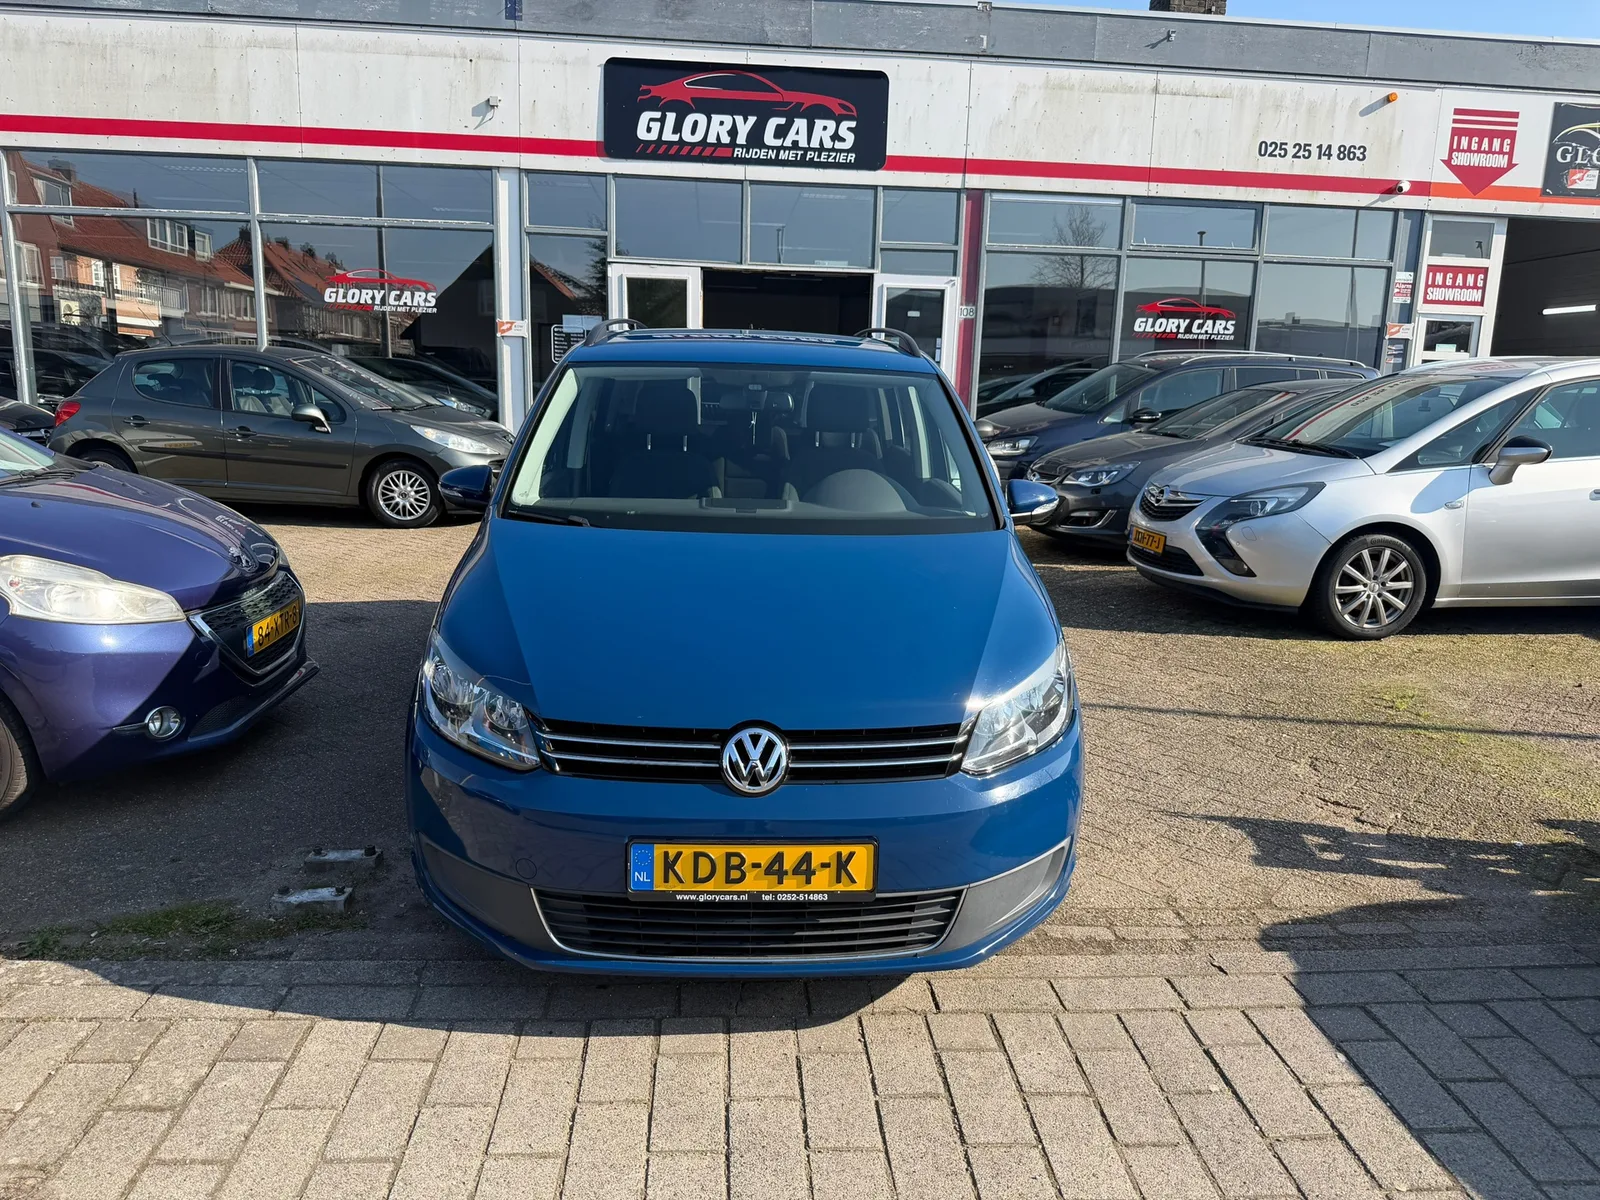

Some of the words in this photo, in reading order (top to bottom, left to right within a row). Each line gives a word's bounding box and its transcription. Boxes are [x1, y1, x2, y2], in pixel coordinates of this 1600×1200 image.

[636, 110, 757, 145] GLORY
[763, 116, 858, 150] CARS
[1258, 140, 1289, 158] 025
[1291, 142, 1312, 160] 25
[1316, 143, 1333, 161] 14
[1336, 144, 1368, 162] 863
[1452, 135, 1511, 153] INGANG
[733, 147, 776, 160] RIJDEN
[778, 150, 803, 161] MET
[806, 152, 856, 163] PLEZIER
[1451, 151, 1509, 168] SHOWROOM
[1427, 271, 1485, 287] INGANG
[323, 287, 385, 305] GLORY
[388, 290, 437, 307] CARS
[1426, 286, 1483, 302] SHOWROOM
[411, 306, 438, 314] PLEZIER
[960, 307, 975, 317] 108
[1133, 317, 1191, 333] GLORY
[1191, 319, 1236, 335] CARS
[257, 604, 298, 648] 84-XTR-8
[634, 871, 651, 882] NL
[662, 850, 858, 885] KDB-44-K
[675, 893, 749, 902] www.glorycars.nl
[761, 893, 776, 901] tel:
[776, 893, 829, 902] 0252-514863
